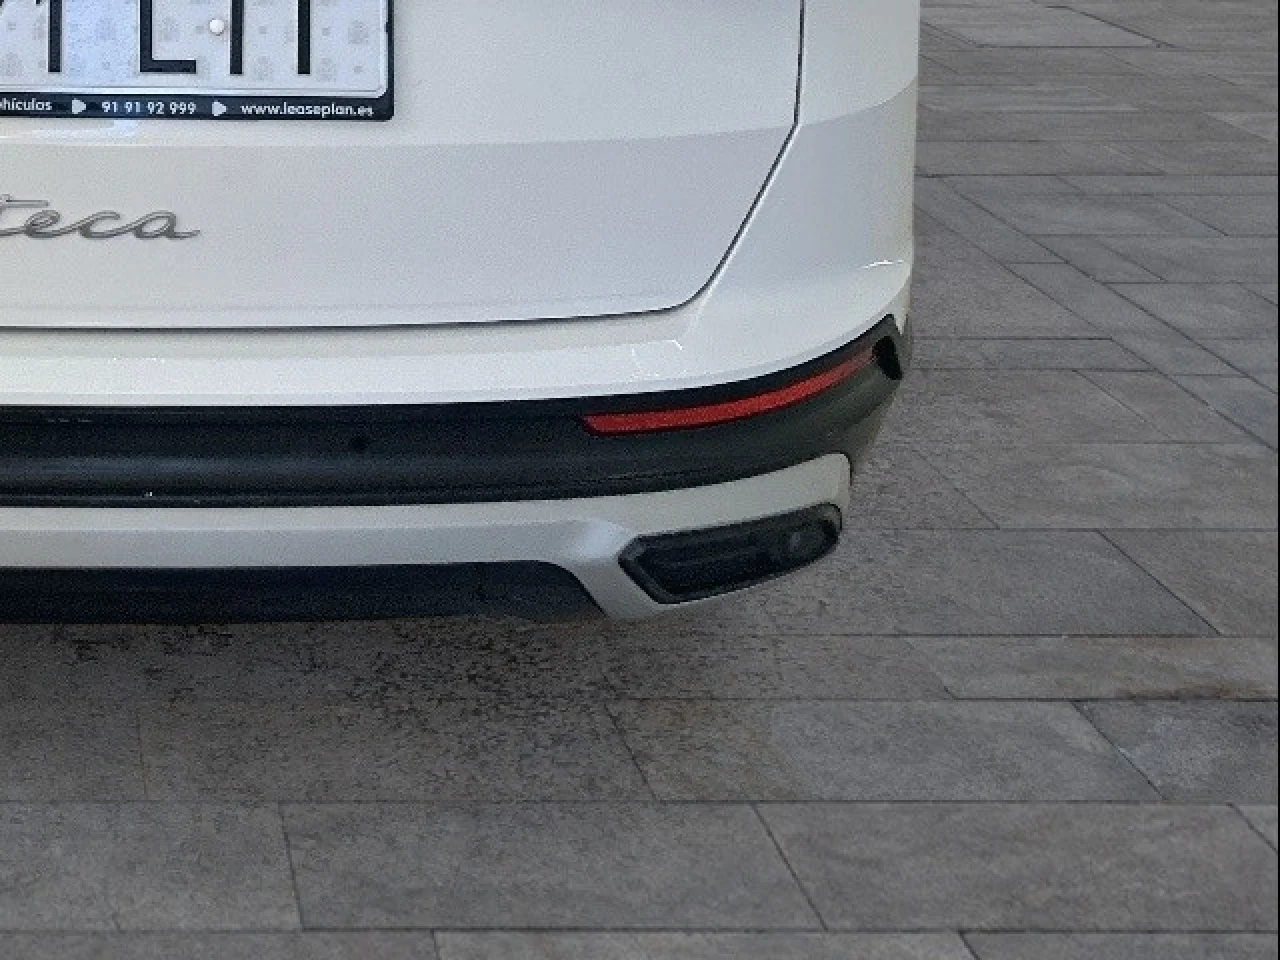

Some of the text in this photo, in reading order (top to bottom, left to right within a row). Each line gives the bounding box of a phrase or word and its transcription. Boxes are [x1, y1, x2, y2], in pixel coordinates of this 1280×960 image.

[101, 100, 118, 113] 91
[124, 100, 142, 114] 91
[147, 100, 165, 115] 92
[169, 101, 197, 116] 999
[241, 101, 374, 119] www.leaseplan.es
